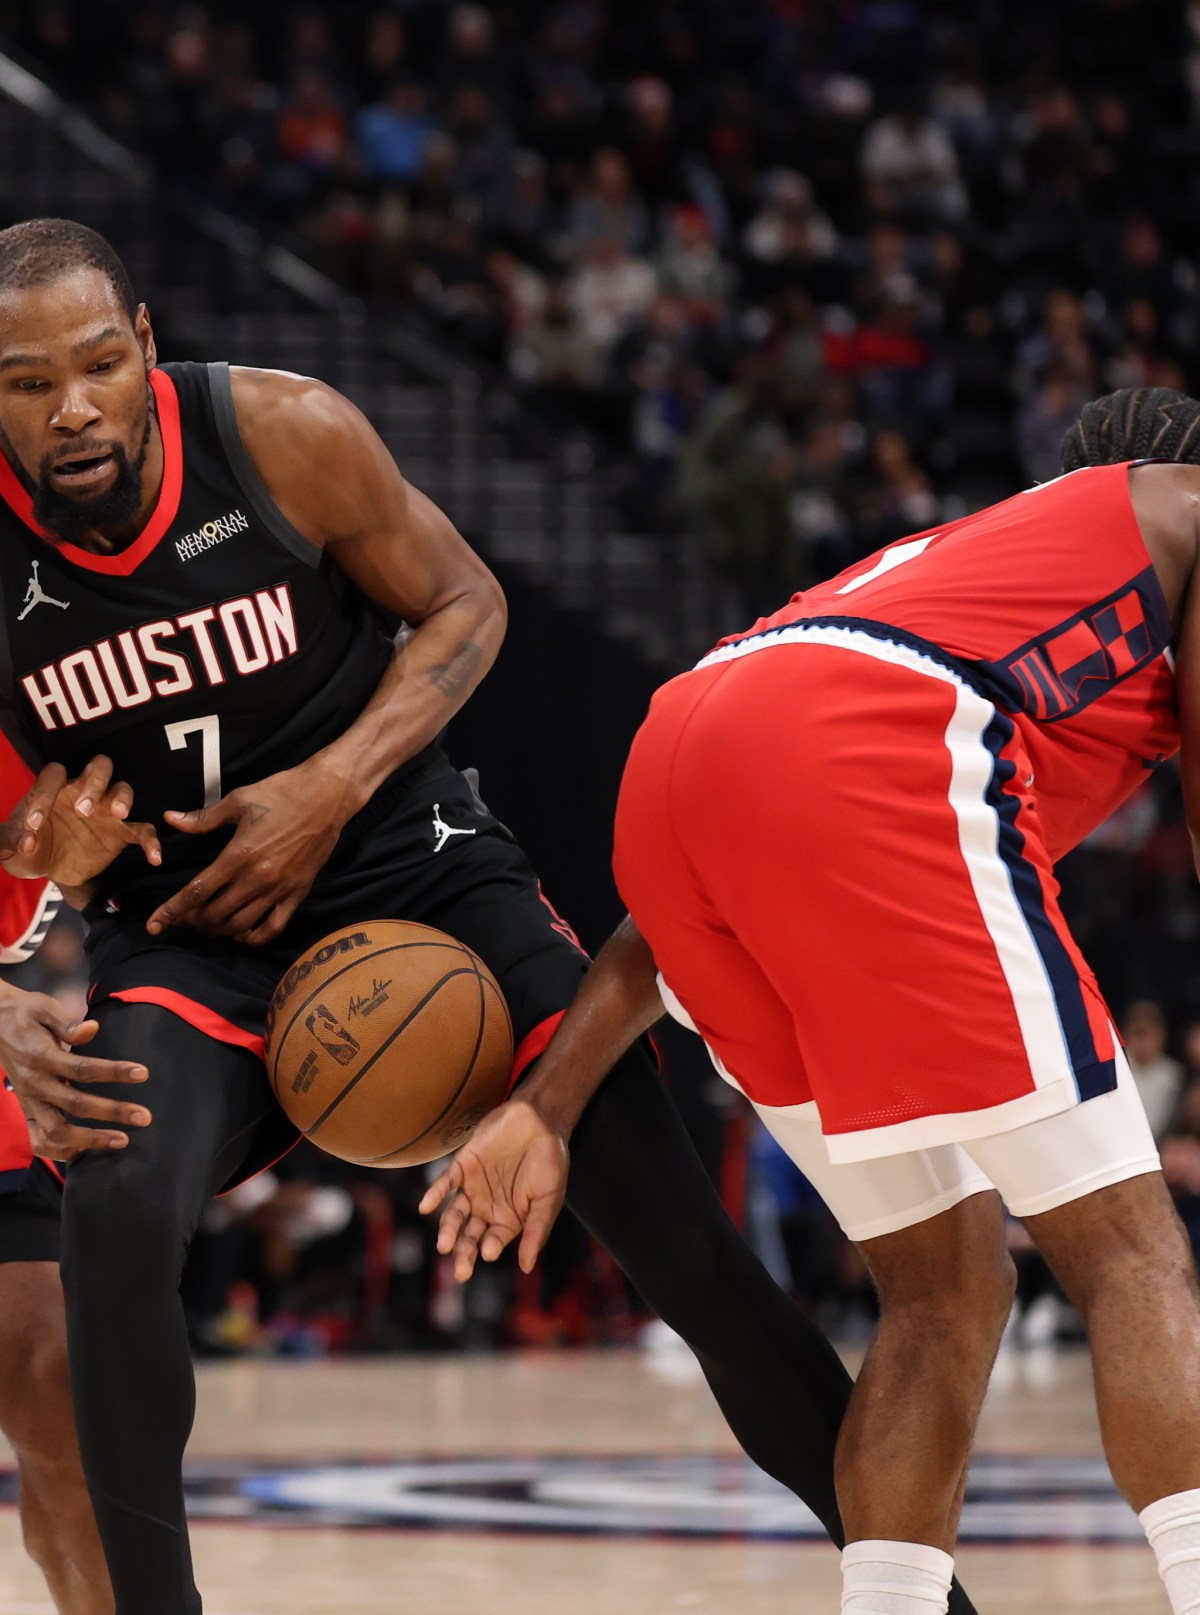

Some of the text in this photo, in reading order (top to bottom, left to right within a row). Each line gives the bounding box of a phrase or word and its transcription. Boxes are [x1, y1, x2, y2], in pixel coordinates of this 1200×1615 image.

[175, 509, 246, 552] MEMORIAL
[178, 517, 249, 562] HERMANN
[20, 581, 299, 732] HOUSTON
[163, 714, 221, 811] 7
